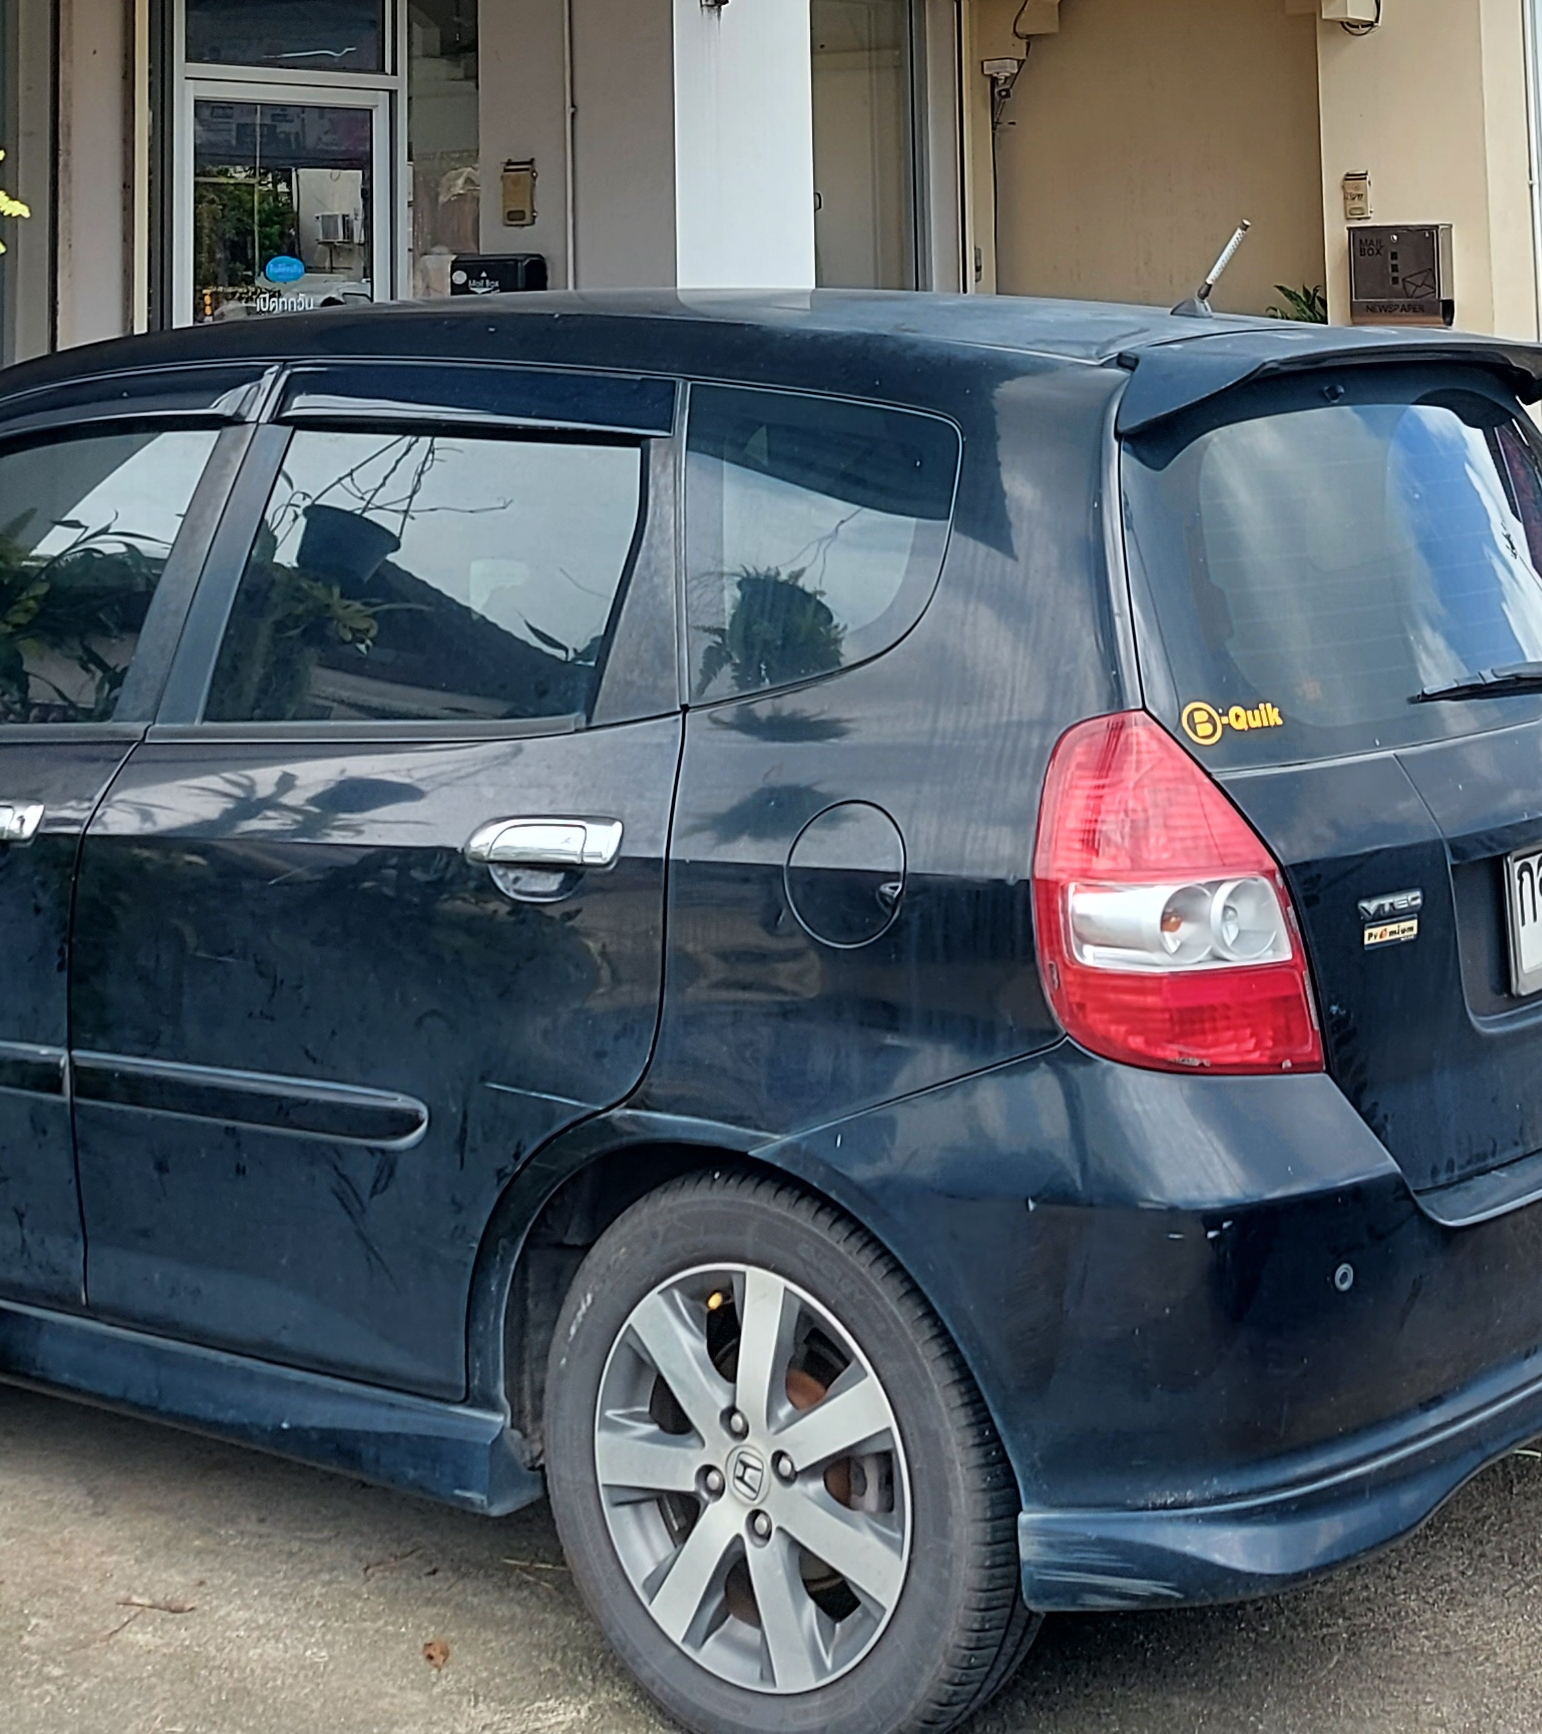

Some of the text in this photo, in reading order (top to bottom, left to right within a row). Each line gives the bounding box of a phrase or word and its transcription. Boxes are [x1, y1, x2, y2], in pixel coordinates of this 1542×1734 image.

[1359, 248, 1382, 257] BOX
[1366, 304, 1424, 313] NEWSPAPER
[1358, 892, 1422, 918] VTEC
